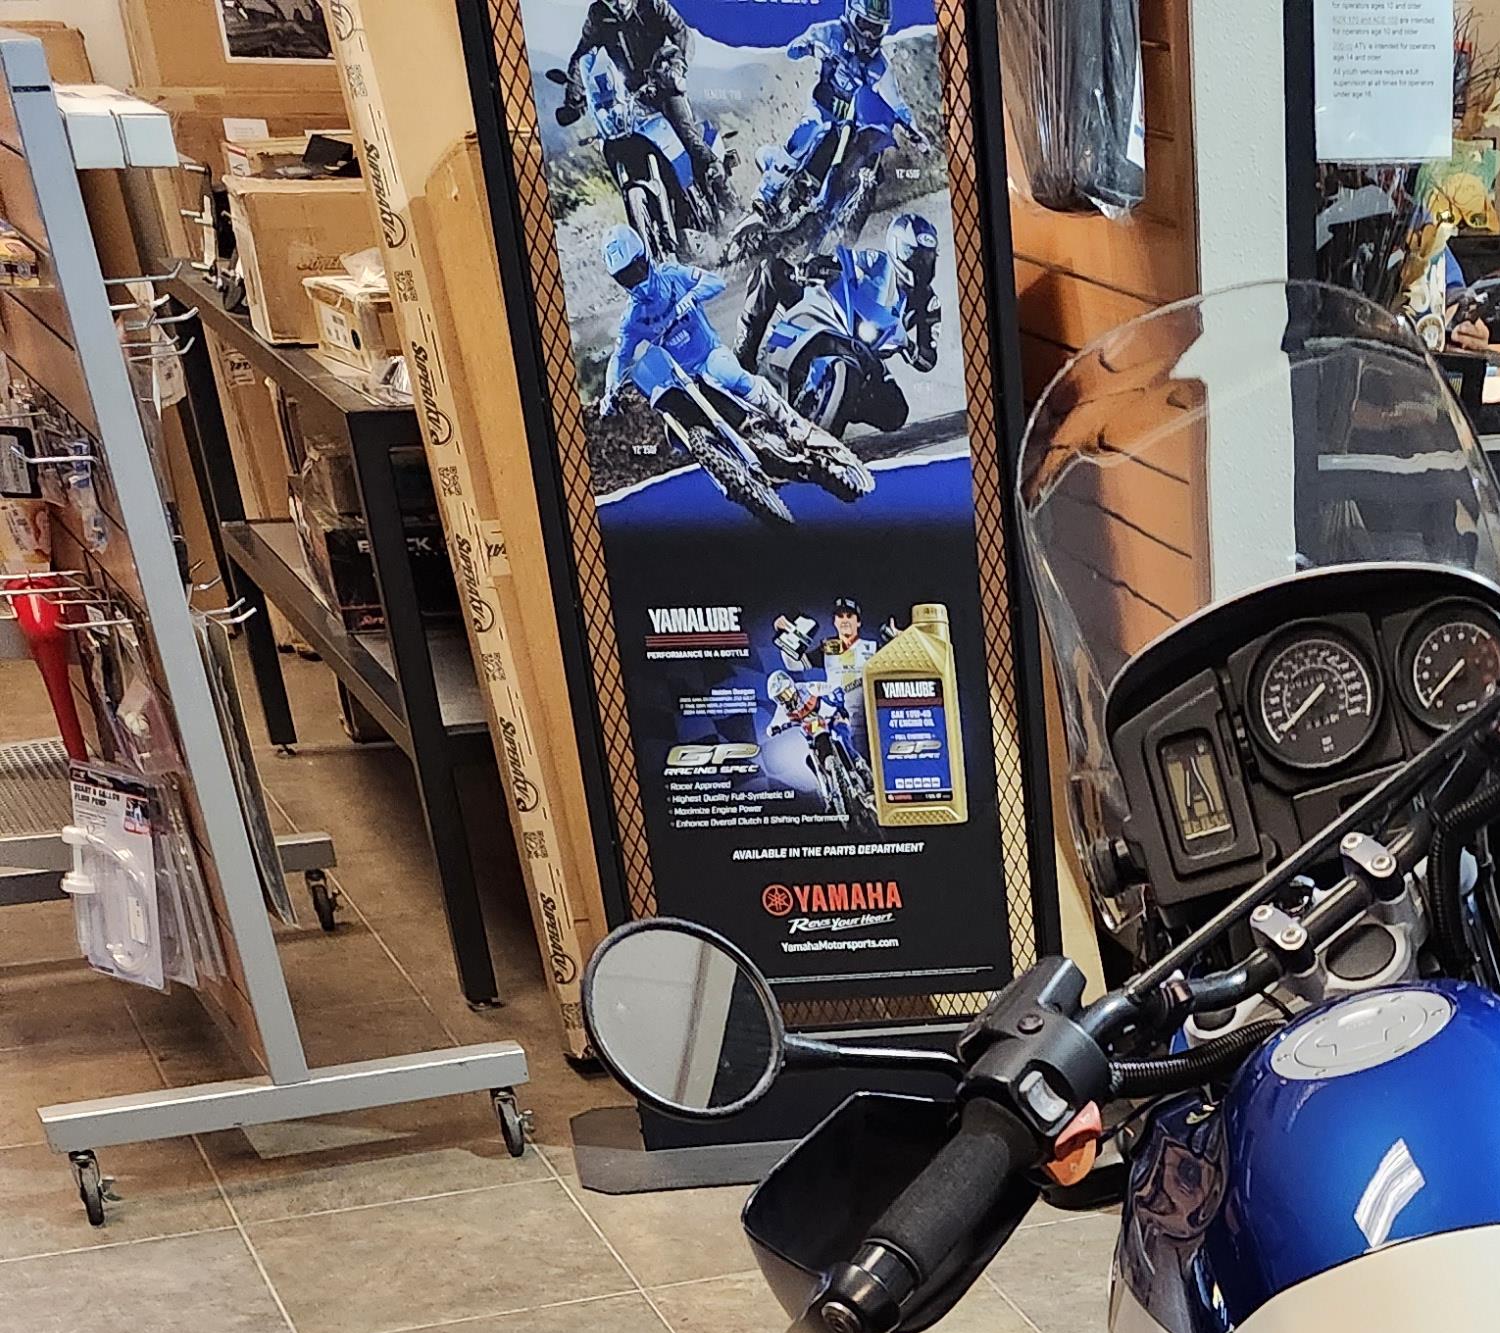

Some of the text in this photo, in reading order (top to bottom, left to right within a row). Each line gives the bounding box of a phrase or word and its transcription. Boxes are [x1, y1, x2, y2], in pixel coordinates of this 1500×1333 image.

[648, 606, 741, 633] YAMALUBE
[647, 651, 703, 660] PERFORMANCE
[720, 649, 749, 658] BOTTLE
[882, 681, 937, 698] YAMALUBE
[666, 743, 760, 766] GP
[664, 764, 759, 776] RACING SPEC
[670, 781, 731, 791] Racer Approved
[672, 795, 701, 804] Highest
[704, 793, 730, 803] Quality
[674, 804, 763, 816] Maximize Engine Power
[676, 820, 709, 828] Enhance
[711, 818, 736, 827] Overall
[738, 817, 762, 826] Clutch
[770, 815, 800, 825] Shifting
[733, 842, 925, 860] AVAILABLE IN THE PARTS DEPARTMENT
[793, 881, 902, 912] YAMAHA
[860, 913, 894, 925] Heart
[781, 938, 899, 953] YamahaMotorsports.com
